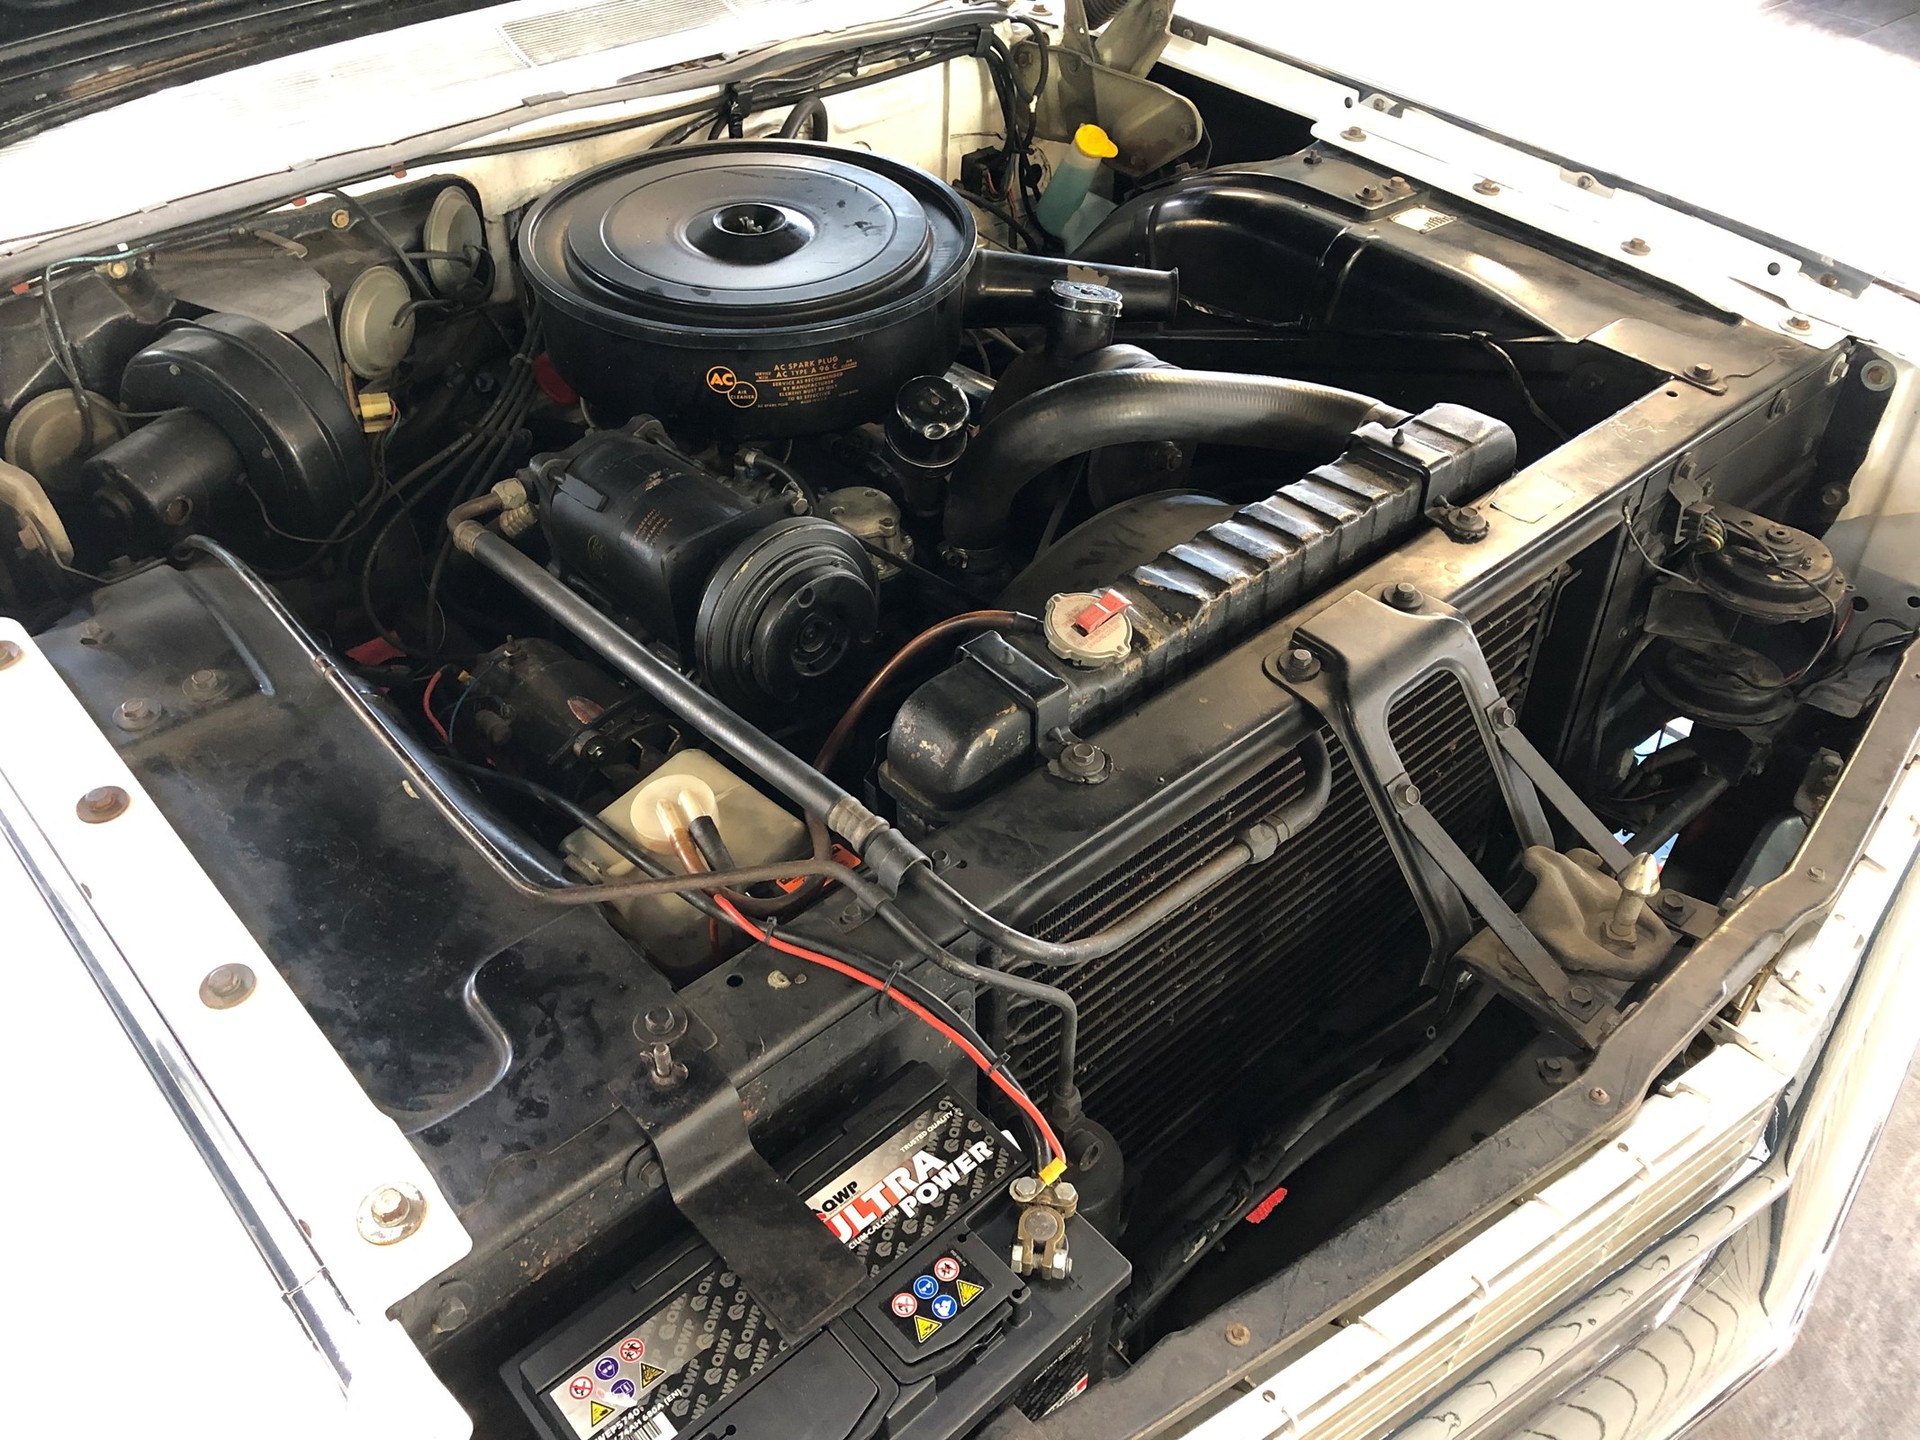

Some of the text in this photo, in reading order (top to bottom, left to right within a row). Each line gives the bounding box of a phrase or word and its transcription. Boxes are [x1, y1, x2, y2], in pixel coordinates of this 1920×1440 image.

[710, 372, 734, 386] AC
[788, 360, 815, 369] SPARK
[817, 355, 839, 365] PLUG
[900, 1130, 928, 1153] TRUSTED
[927, 1110, 953, 1133] QUALITY
[899, 1141, 994, 1219] POWER
[994, 1147, 1009, 1179] QWP
[822, 1181, 858, 1213] QWP
[704, 1296, 724, 1333] QWP
[741, 1304, 761, 1342] QWP
[711, 1328, 732, 1367] QWP
[680, 1358, 701, 1398] QWP
[642, 1402, 665, 1422] 680A
[663, 1388, 683, 1406] (EN)
